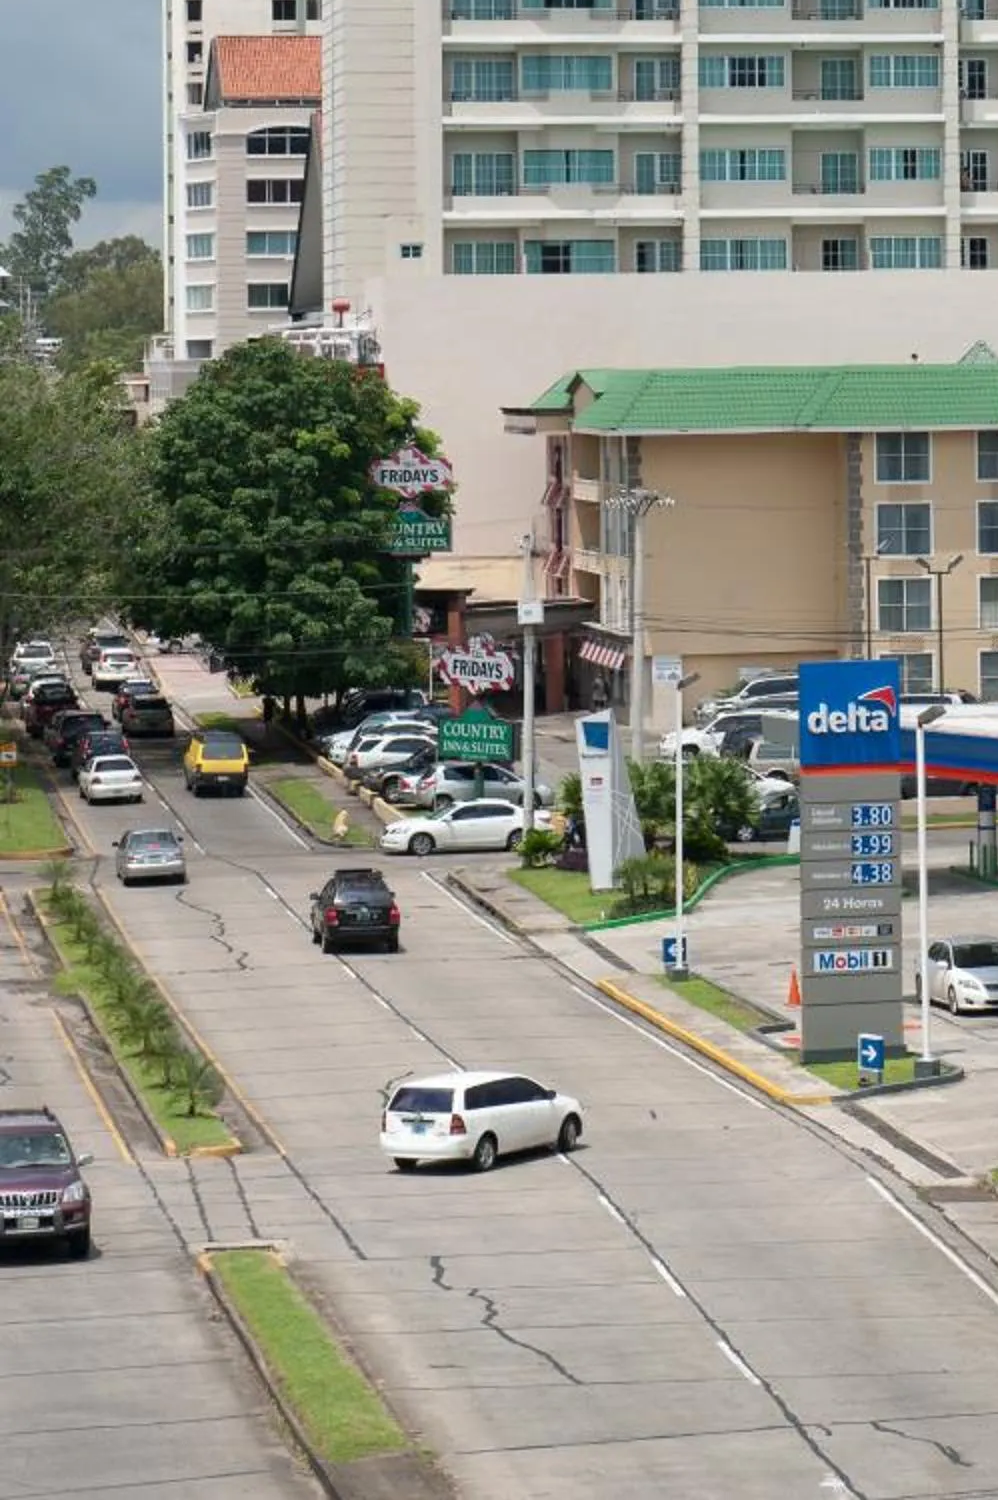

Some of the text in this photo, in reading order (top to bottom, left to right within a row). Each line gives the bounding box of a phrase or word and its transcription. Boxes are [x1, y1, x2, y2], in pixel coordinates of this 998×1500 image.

[391, 523, 445, 535] UNTRY
[807, 702, 889, 734] delta
[443, 722, 507, 740] COUNTRY
[853, 806, 892, 825] 3.80
[853, 835, 892, 855] 3.99
[852, 864, 892, 883] 4.38
[823, 896, 883, 910] 24 Horas
[819, 951, 887, 970] Mobil 1
